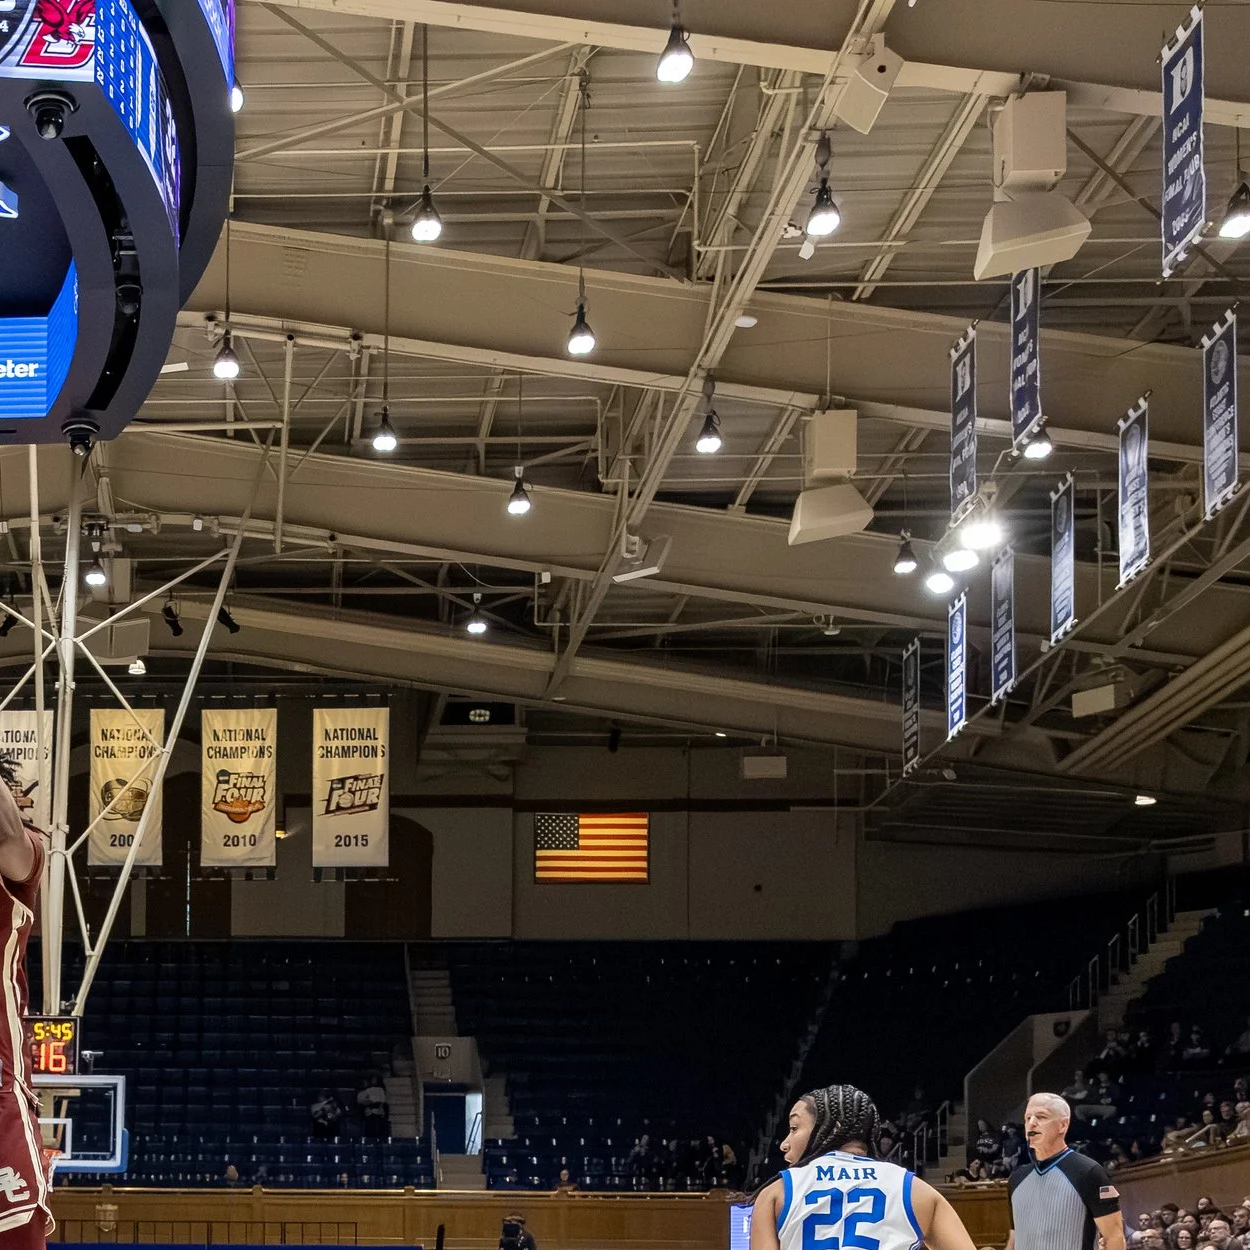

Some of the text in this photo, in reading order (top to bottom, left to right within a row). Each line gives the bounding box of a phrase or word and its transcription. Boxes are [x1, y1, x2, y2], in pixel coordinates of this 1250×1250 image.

[213, 728, 266, 742] NATIONAL
[324, 728, 378, 742] NATIONAL
[207, 745, 272, 759] CHAMPIONS
[318, 745, 385, 758] CHAMPIONS
[230, 773, 266, 788] FINAL
[345, 777, 382, 792] FINAL
[110, 834, 142, 847] 200
[223, 834, 257, 847] 2010
[334, 834, 369, 847] 2015
[34, 1022, 73, 1040] 5:45
[39, 1041, 67, 1072] 16
[815, 1165, 877, 1181] MAIR
